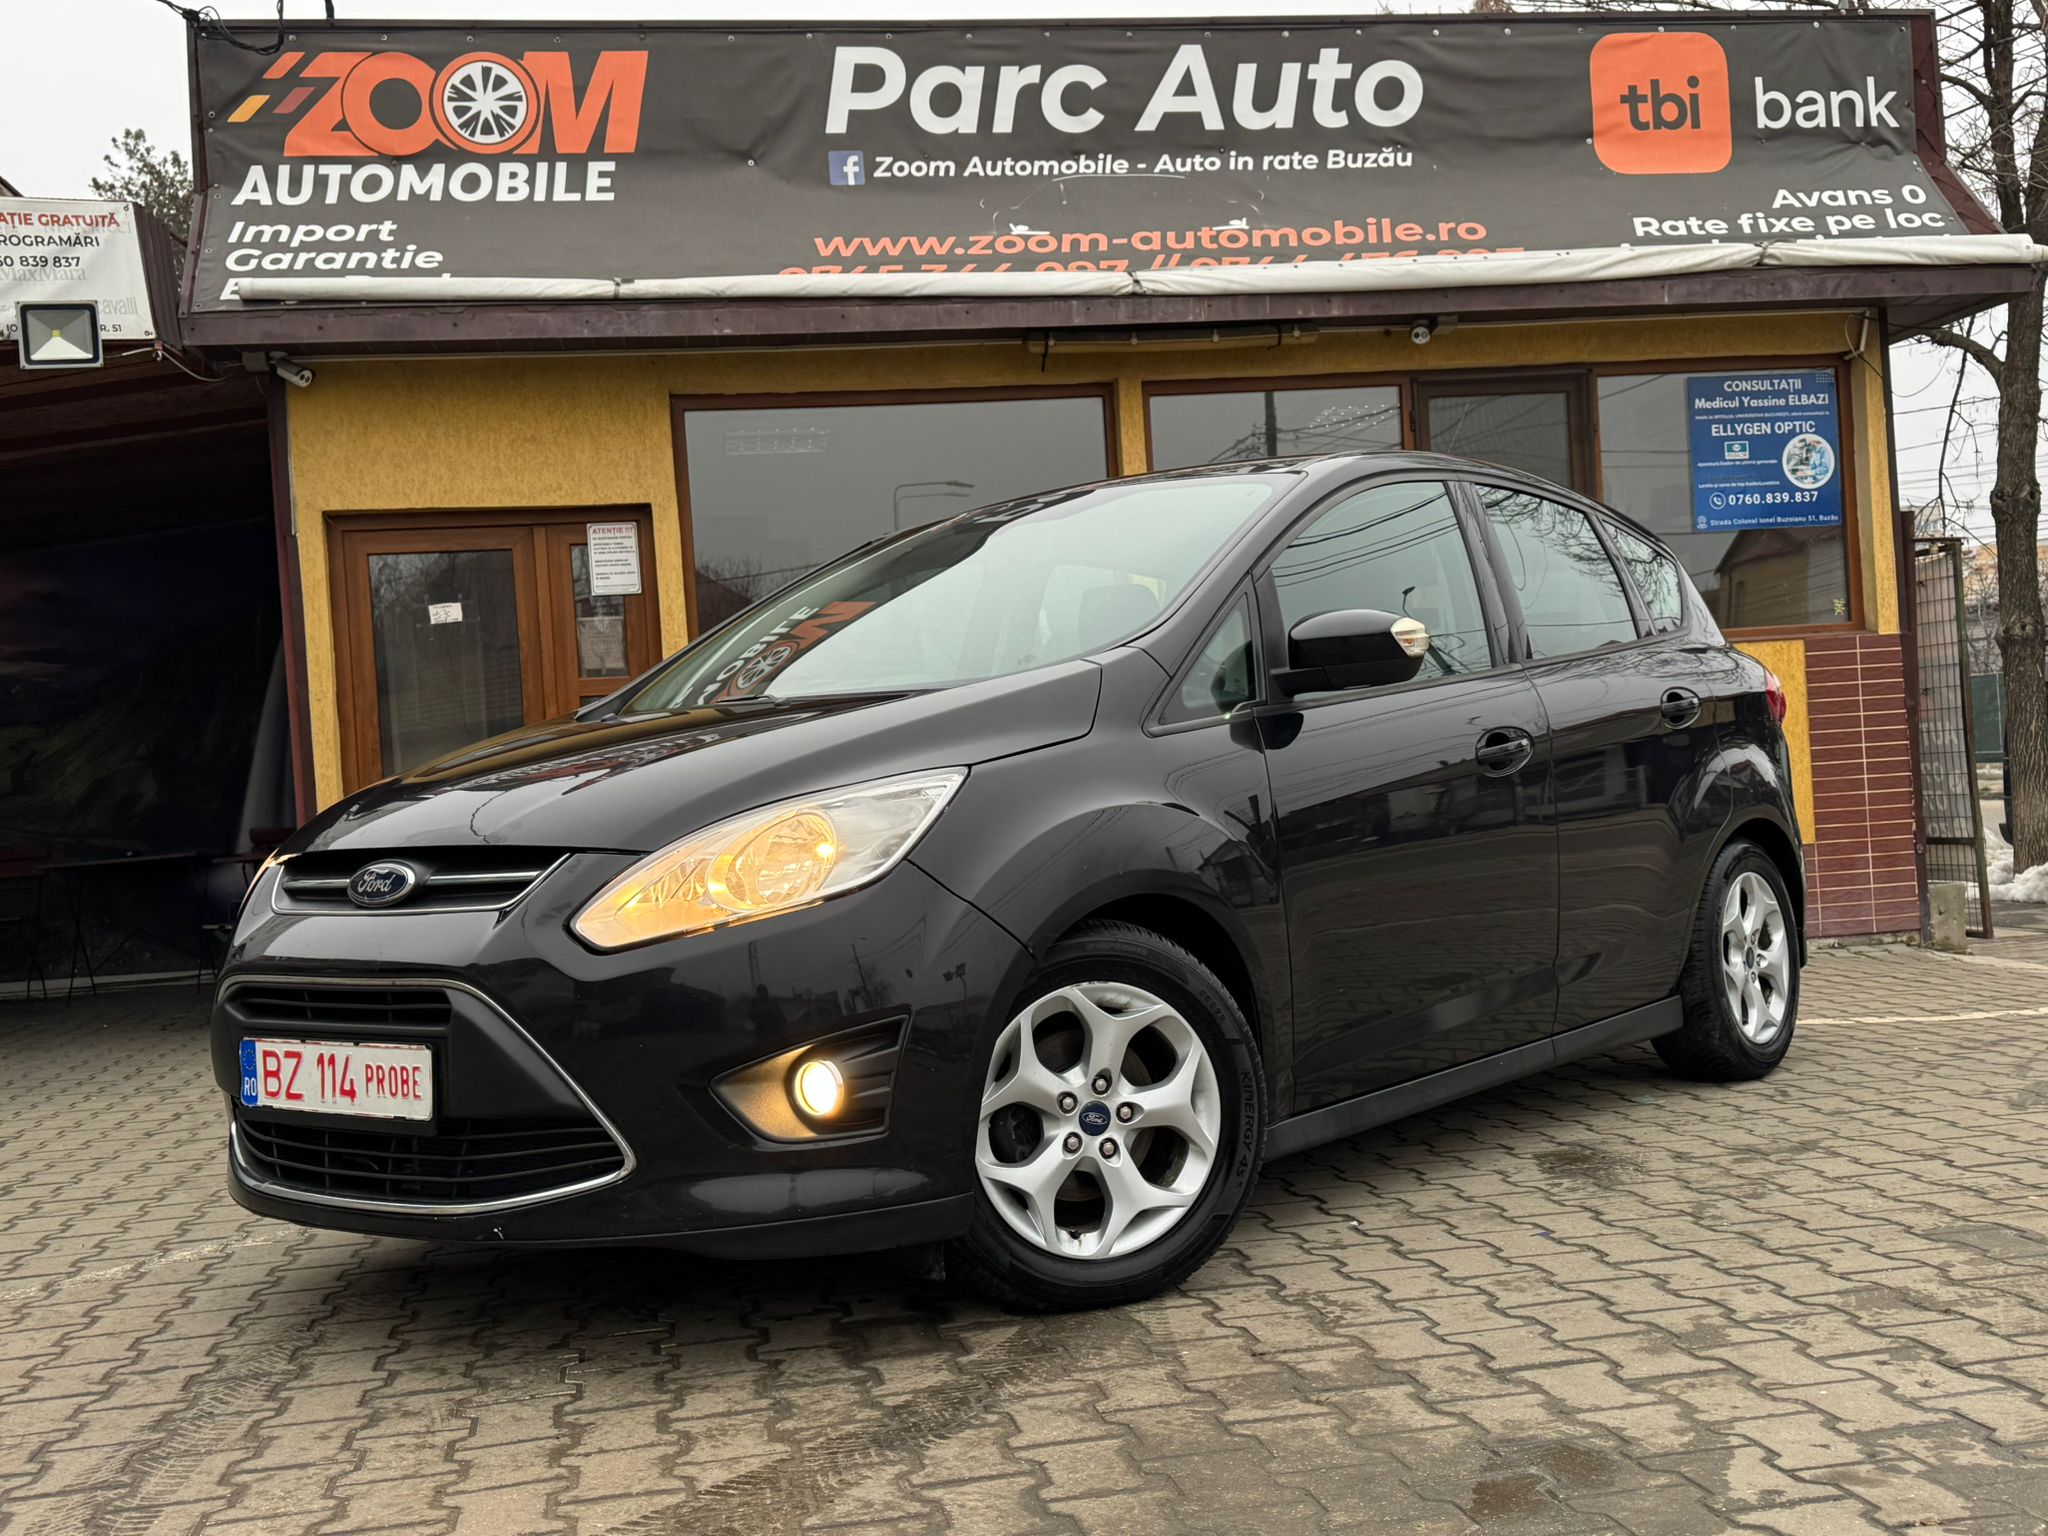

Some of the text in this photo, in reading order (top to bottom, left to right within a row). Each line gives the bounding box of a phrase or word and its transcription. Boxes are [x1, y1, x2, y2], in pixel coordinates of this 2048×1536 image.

[824, 44, 1425, 135] Parc Auto
[1754, 76, 1901, 129] bank
[283, 50, 649, 157] ZOOM
[1619, 75, 1701, 131] tbi
[872, 156, 956, 179] Zoom
[963, 155, 1130, 177] Automobile
[1153, 153, 1222, 174] Auto
[1228, 151, 1255, 171] in
[1262, 151, 1320, 171] rate
[1326, 147, 1414, 170] Buzău
[231, 161, 616, 206] AUTOMOBILE
[1772, 184, 1926, 209] Avans 0
[37, 212, 120, 228] GRATUITĂ
[1632, 207, 1946, 237] Rate fixe pe loc
[227, 220, 398, 248] Import
[814, 217, 1487, 257] www.zoom-automobile.ro
[19, 255, 48, 268] 839
[53, 256, 81, 268] 837
[225, 244, 444, 272] Garantie
[98, 296, 138, 315] avalli
[112, 324, 122, 332] 51
[1723, 378, 1802, 392] CONSULTAȚII
[1694, 393, 1829, 409] Medicul Yassine ELBAZI
[1711, 420, 1816, 436] ELLYGEN OPTIC
[1728, 491, 1818, 505] 0760.839.837
[357, 869, 393, 894] Ford
[243, 1077, 257, 1097] RO
[262, 1049, 422, 1102] BZ 114 PROBE
